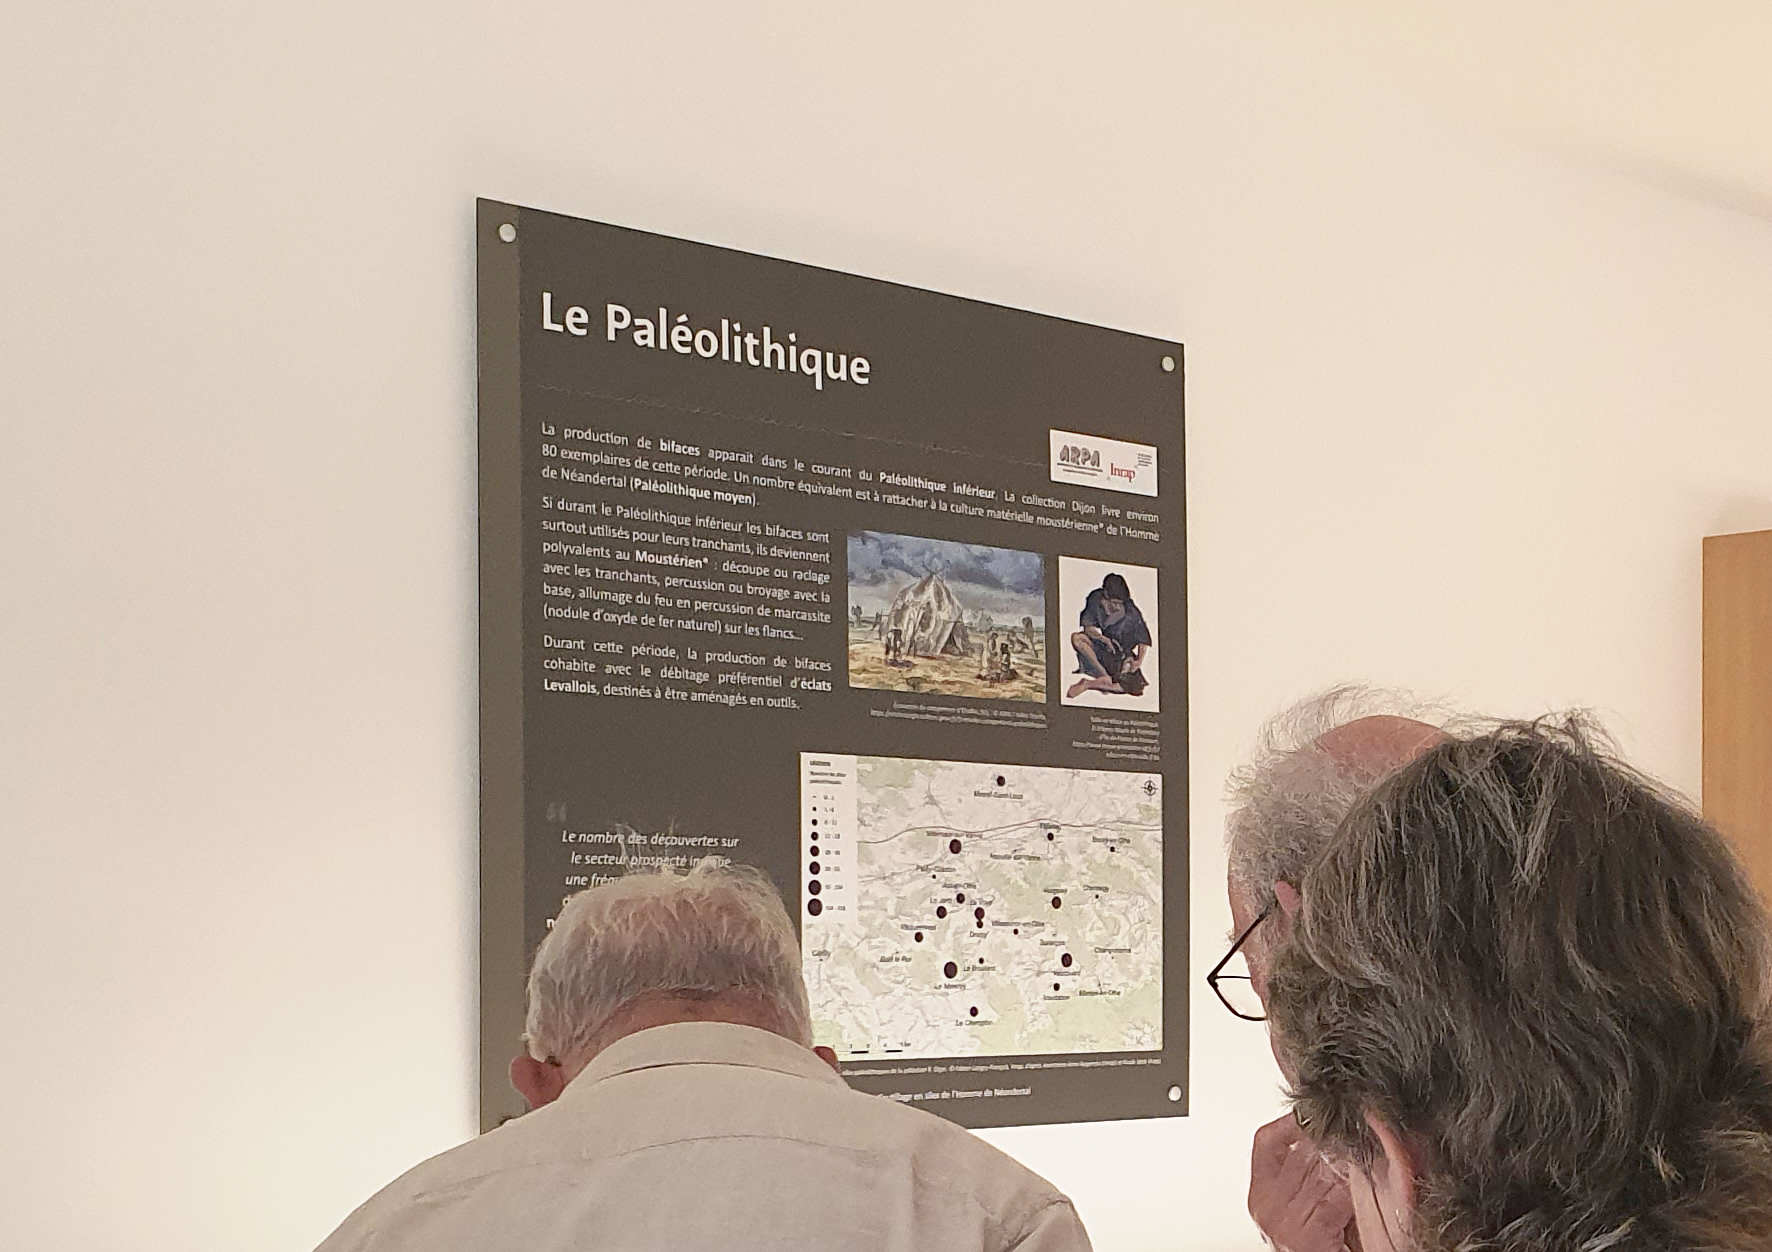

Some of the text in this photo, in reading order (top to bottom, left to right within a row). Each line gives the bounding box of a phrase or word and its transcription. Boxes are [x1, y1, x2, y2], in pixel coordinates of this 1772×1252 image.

[542, 291, 871, 391] Le Paléolithique
[542, 421, 556, 436] La
[564, 427, 629, 446] production
[637, 435, 652, 450] de
[660, 438, 701, 457] bifaces
[762, 454, 788, 469] dans
[794, 458, 805, 472] le
[812, 464, 852, 479] courant
[859, 469, 873, 482] du
[880, 471, 947, 493] Paléolithique
[1005, 490, 1016, 503] La
[1022, 493, 1066, 510] collection
[1072, 500, 1096, 515] Dijon
[1127, 510, 1159, 524] environ
[1060, 444, 1100, 468] ARPA
[542, 464, 558, 480] de
[561, 467, 627, 488] Néandertal
[630, 476, 711, 500] (Paléolithique
[543, 443, 558, 458] 80
[561, 448, 632, 468] exemplaires
[635, 455, 650, 471] de
[653, 461, 681, 475] cette
[685, 464, 731, 482] période.
[734, 470, 750, 484] Un
[753, 475, 795, 491] nombre
[798, 479, 853, 499] équivalent
[856, 490, 871, 501] est
[874, 490, 880, 502] à
[883, 494, 929, 509] rattacher
[931, 497, 937, 510] à
[939, 499, 948, 512] la
[951, 502, 985, 517] culture
[987, 508, 1035, 524] matérielle
[1107, 523, 1118, 536] de
[542, 495, 830, 544] Si durant le Paléolithique inférieur les bifaces sont
[543, 520, 830, 564] surtout utilisés pour leurs tranchants, ils deviennent
[543, 540, 611, 559] polyvalents
[615, 550, 631, 561] au
[723, 559, 770, 577] découpe
[774, 568, 789, 579] ou
[544, 563, 831, 603] avec les tranchants, percussion ou broyage avec la
[544, 581, 831, 624] base, allumage du feu en percussion de marcassite
[544, 602, 590, 621] (nodule
[593, 607, 638, 626] d'oxyde
[641, 613, 656, 627] de
[659, 614, 675, 628] fer
[725, 623, 743, 634] sur
[745, 622, 761, 637] les
[544, 634, 832, 672] Durant cette période, la production de bifaces
[544, 657, 832, 692] cohabite avec le débitage préférentiel d'éclats
[545, 678, 600, 696] Levallois,
[604, 682, 652, 698] destinés
[655, 685, 662, 699] à
[665, 686, 689, 701] être
[691, 690, 748, 707] aménagés
[750, 696, 765, 706] en
[562, 830, 740, 847] Le nombre des découvertes sur
[571, 851, 582, 865] le
[565, 875, 588, 886] une
